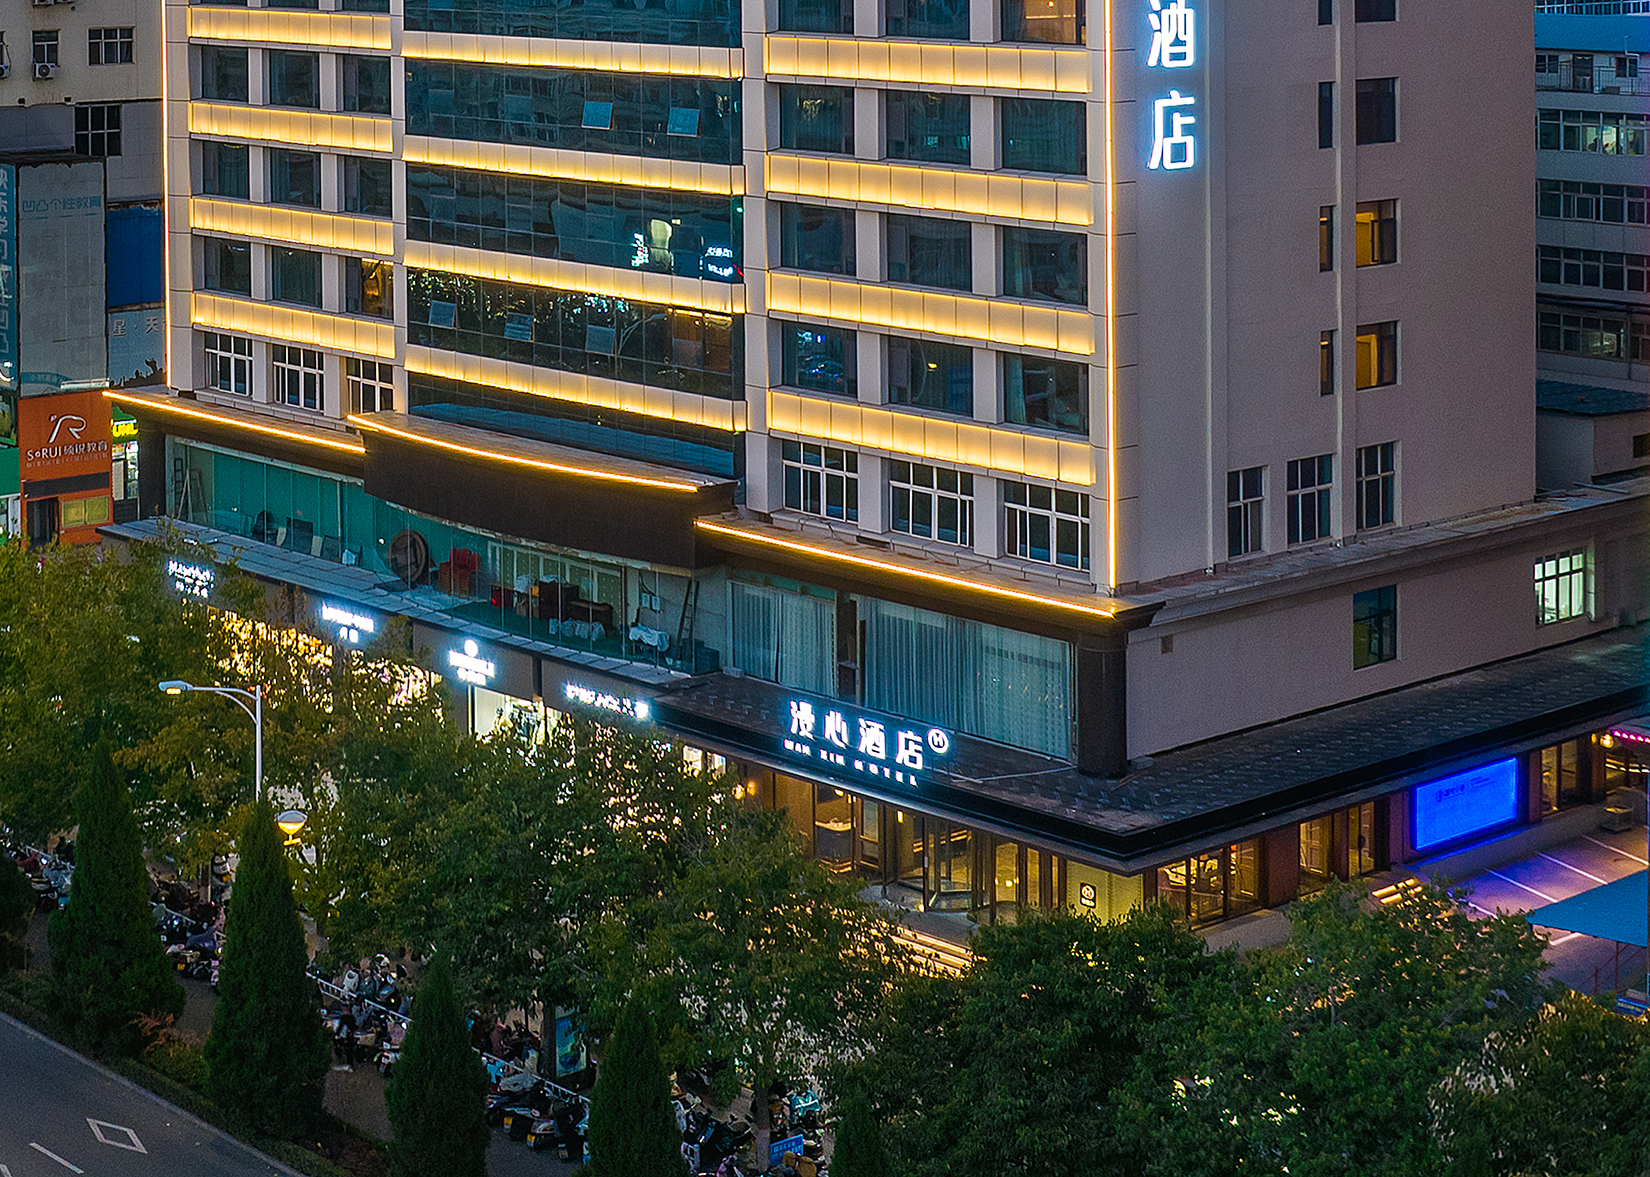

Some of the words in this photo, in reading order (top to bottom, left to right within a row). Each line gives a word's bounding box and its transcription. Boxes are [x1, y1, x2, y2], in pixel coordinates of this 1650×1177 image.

[22, 195, 102, 213] 凹凸个性教育
[789, 699, 924, 771] 漫心酒店
[853, 759, 919, 788] HOTEL
